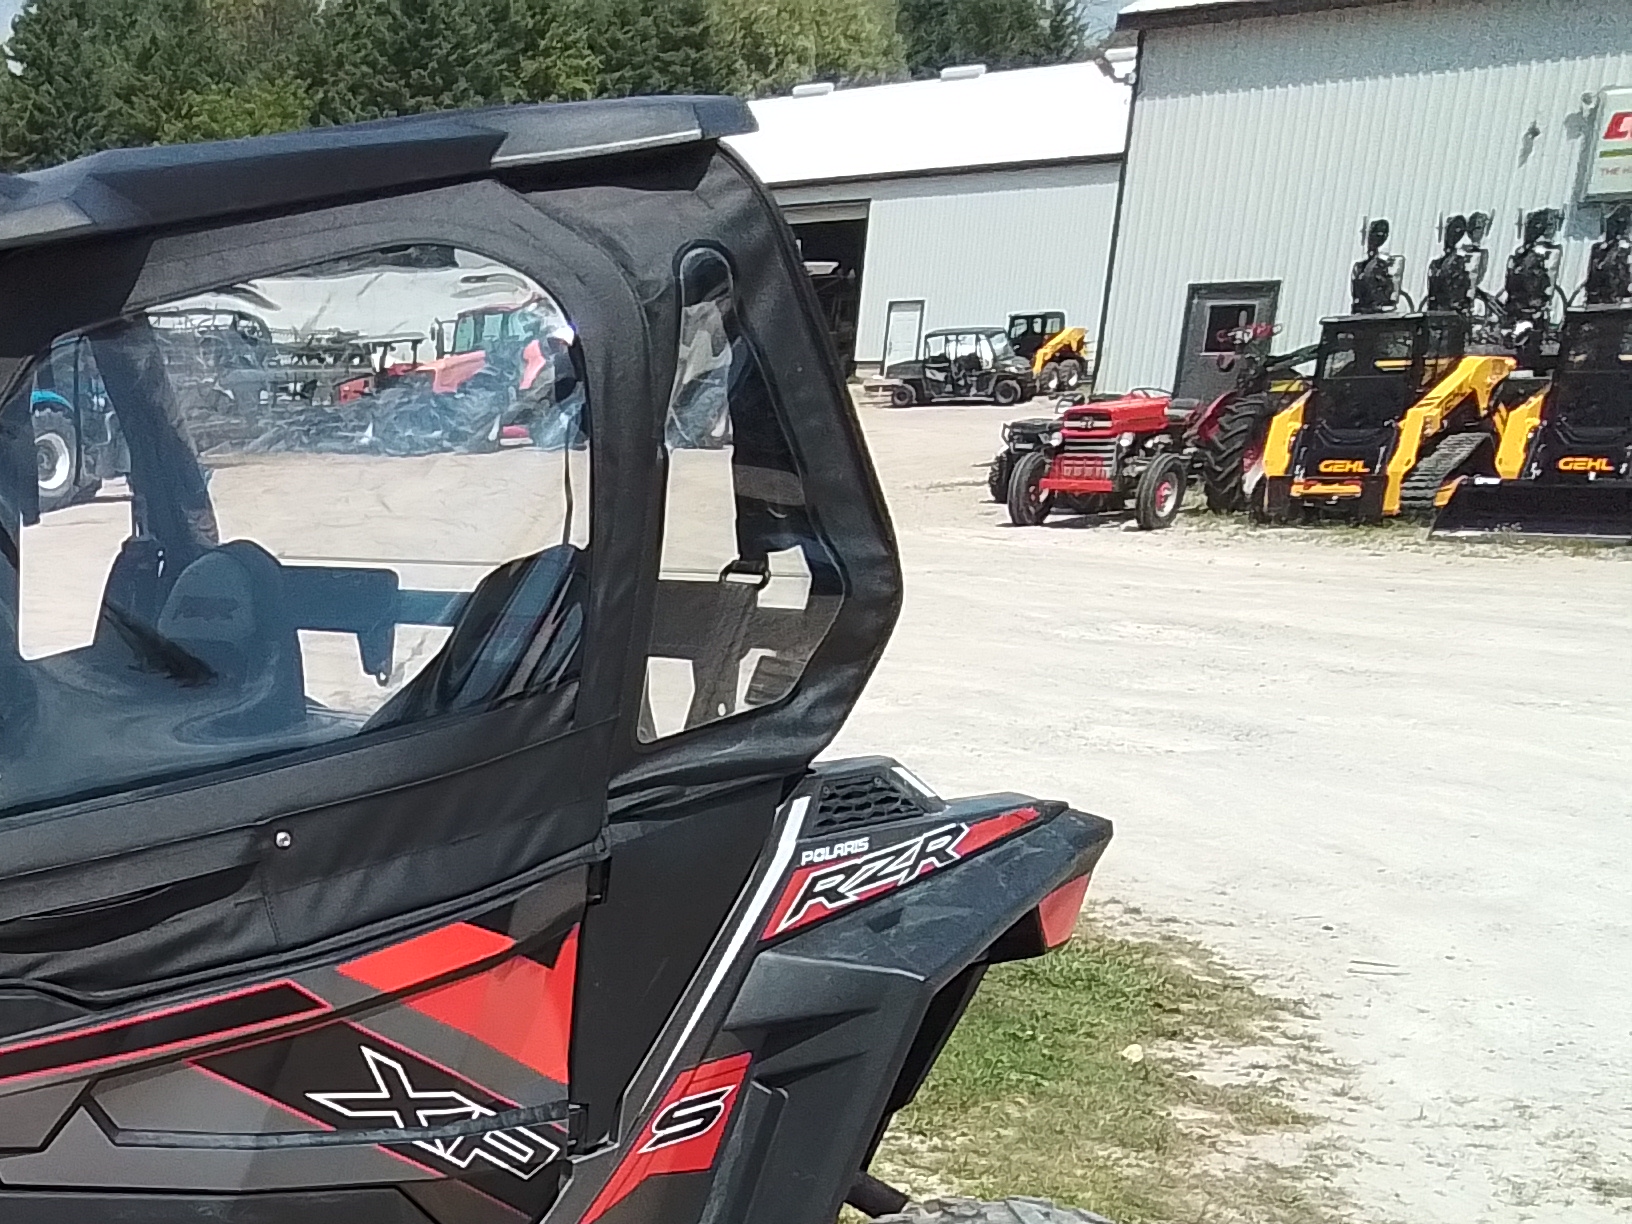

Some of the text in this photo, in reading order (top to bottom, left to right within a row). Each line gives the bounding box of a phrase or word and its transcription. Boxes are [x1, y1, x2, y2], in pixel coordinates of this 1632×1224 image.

[1319, 459, 1371, 473] GEHL
[1558, 457, 1614, 472] GEHL
[800, 836, 870, 866] POLARIS
[774, 822, 970, 934] RZR
[637, 1084, 737, 1154] S
